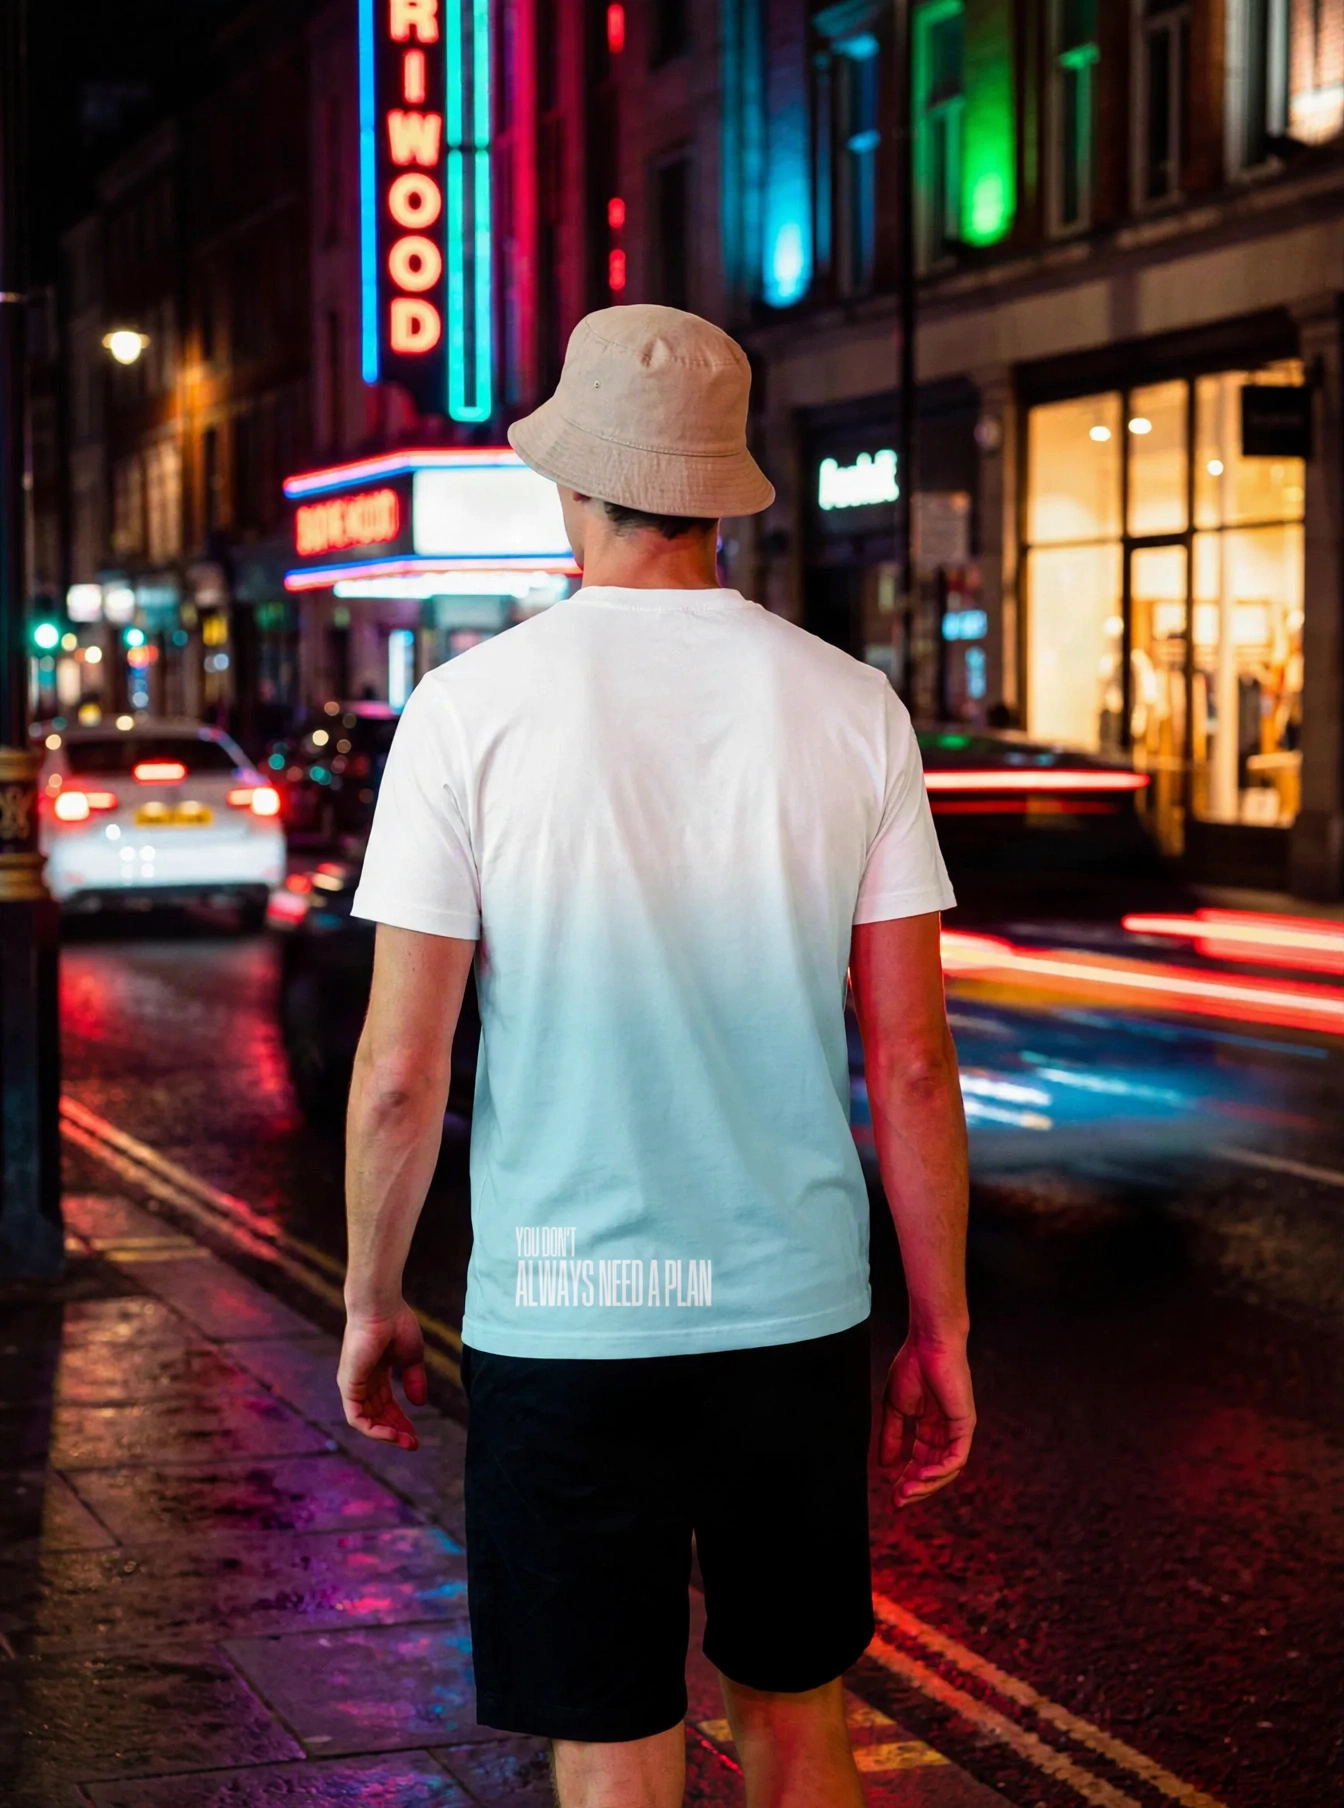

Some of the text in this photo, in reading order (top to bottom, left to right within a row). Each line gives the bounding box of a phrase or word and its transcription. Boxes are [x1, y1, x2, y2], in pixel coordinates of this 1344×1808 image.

[515, 1226, 577, 1257] YOU DON'T
[515, 1259, 713, 1307] ALWAYS NEED A PLAN
